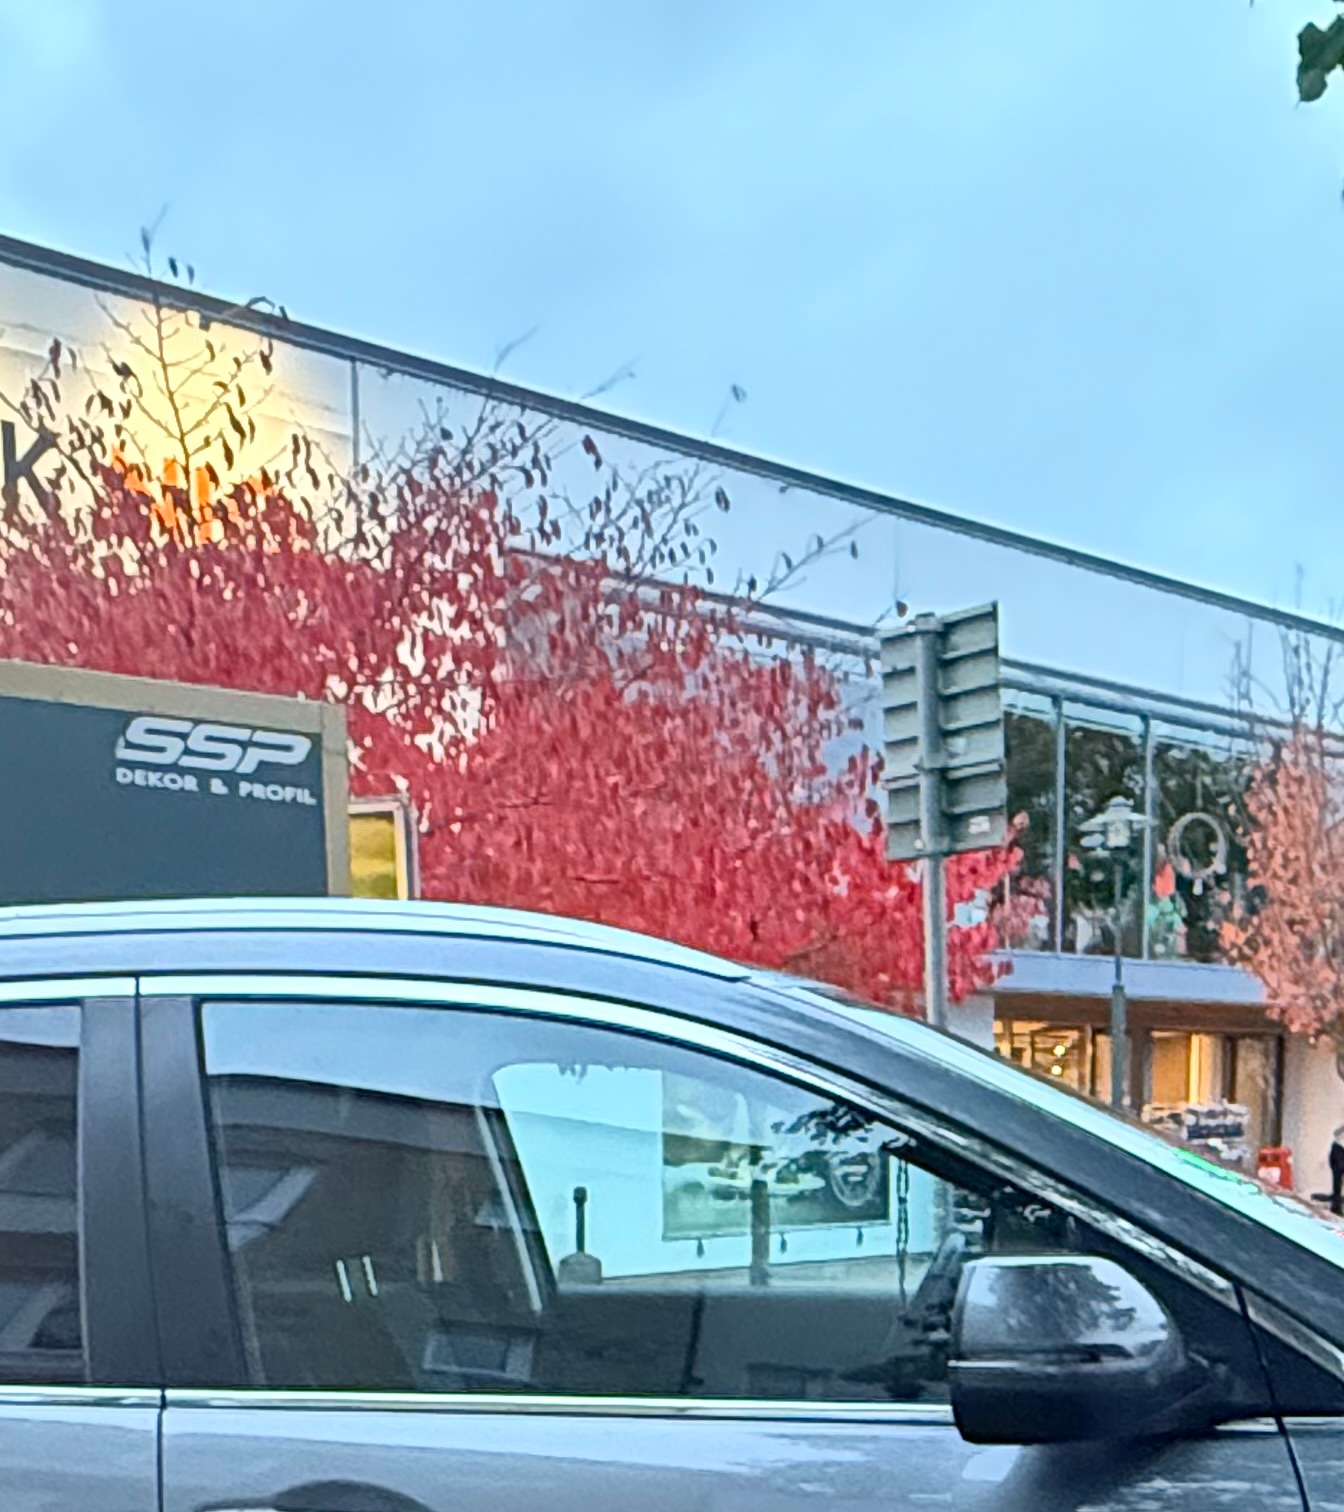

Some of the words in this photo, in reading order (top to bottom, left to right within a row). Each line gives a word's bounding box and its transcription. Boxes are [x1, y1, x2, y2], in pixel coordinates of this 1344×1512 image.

[115, 716, 312, 774] SSP
[115, 767, 200, 793] DEKOR
[209, 777, 229, 796] &
[238, 780, 317, 806] PROFIL
